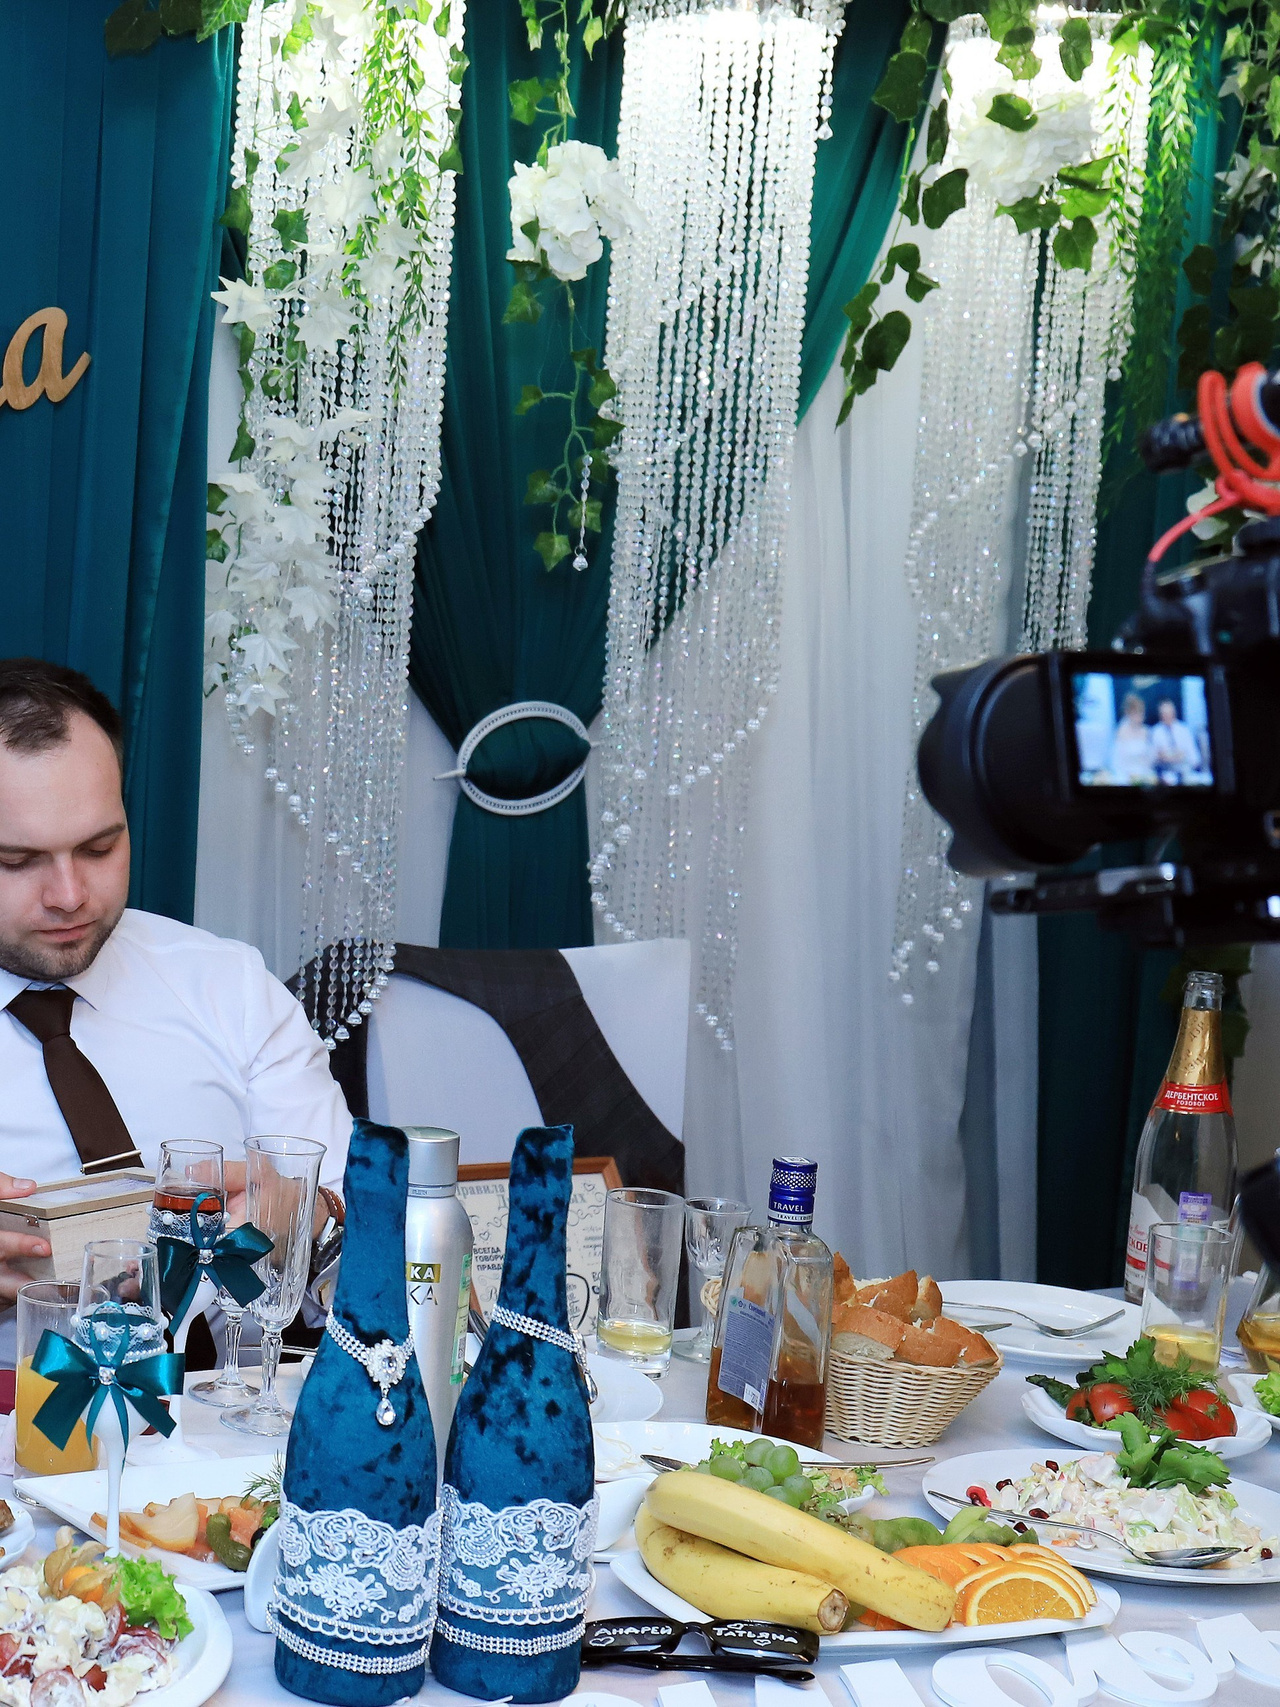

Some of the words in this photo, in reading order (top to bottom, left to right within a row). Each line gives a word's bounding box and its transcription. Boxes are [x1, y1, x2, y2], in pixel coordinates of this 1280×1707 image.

[1164, 1090, 1219, 1102] ДЕРБЕНТСКОЕ
[457, 1184, 505, 1199] равила
[773, 1202, 805, 1212] TRAVEL
[473, 1246, 501, 1255] ВСЕГДА
[476, 1263, 503, 1271] ПРАВД
[712, 1627, 799, 1644] ТАТЬЯНА
